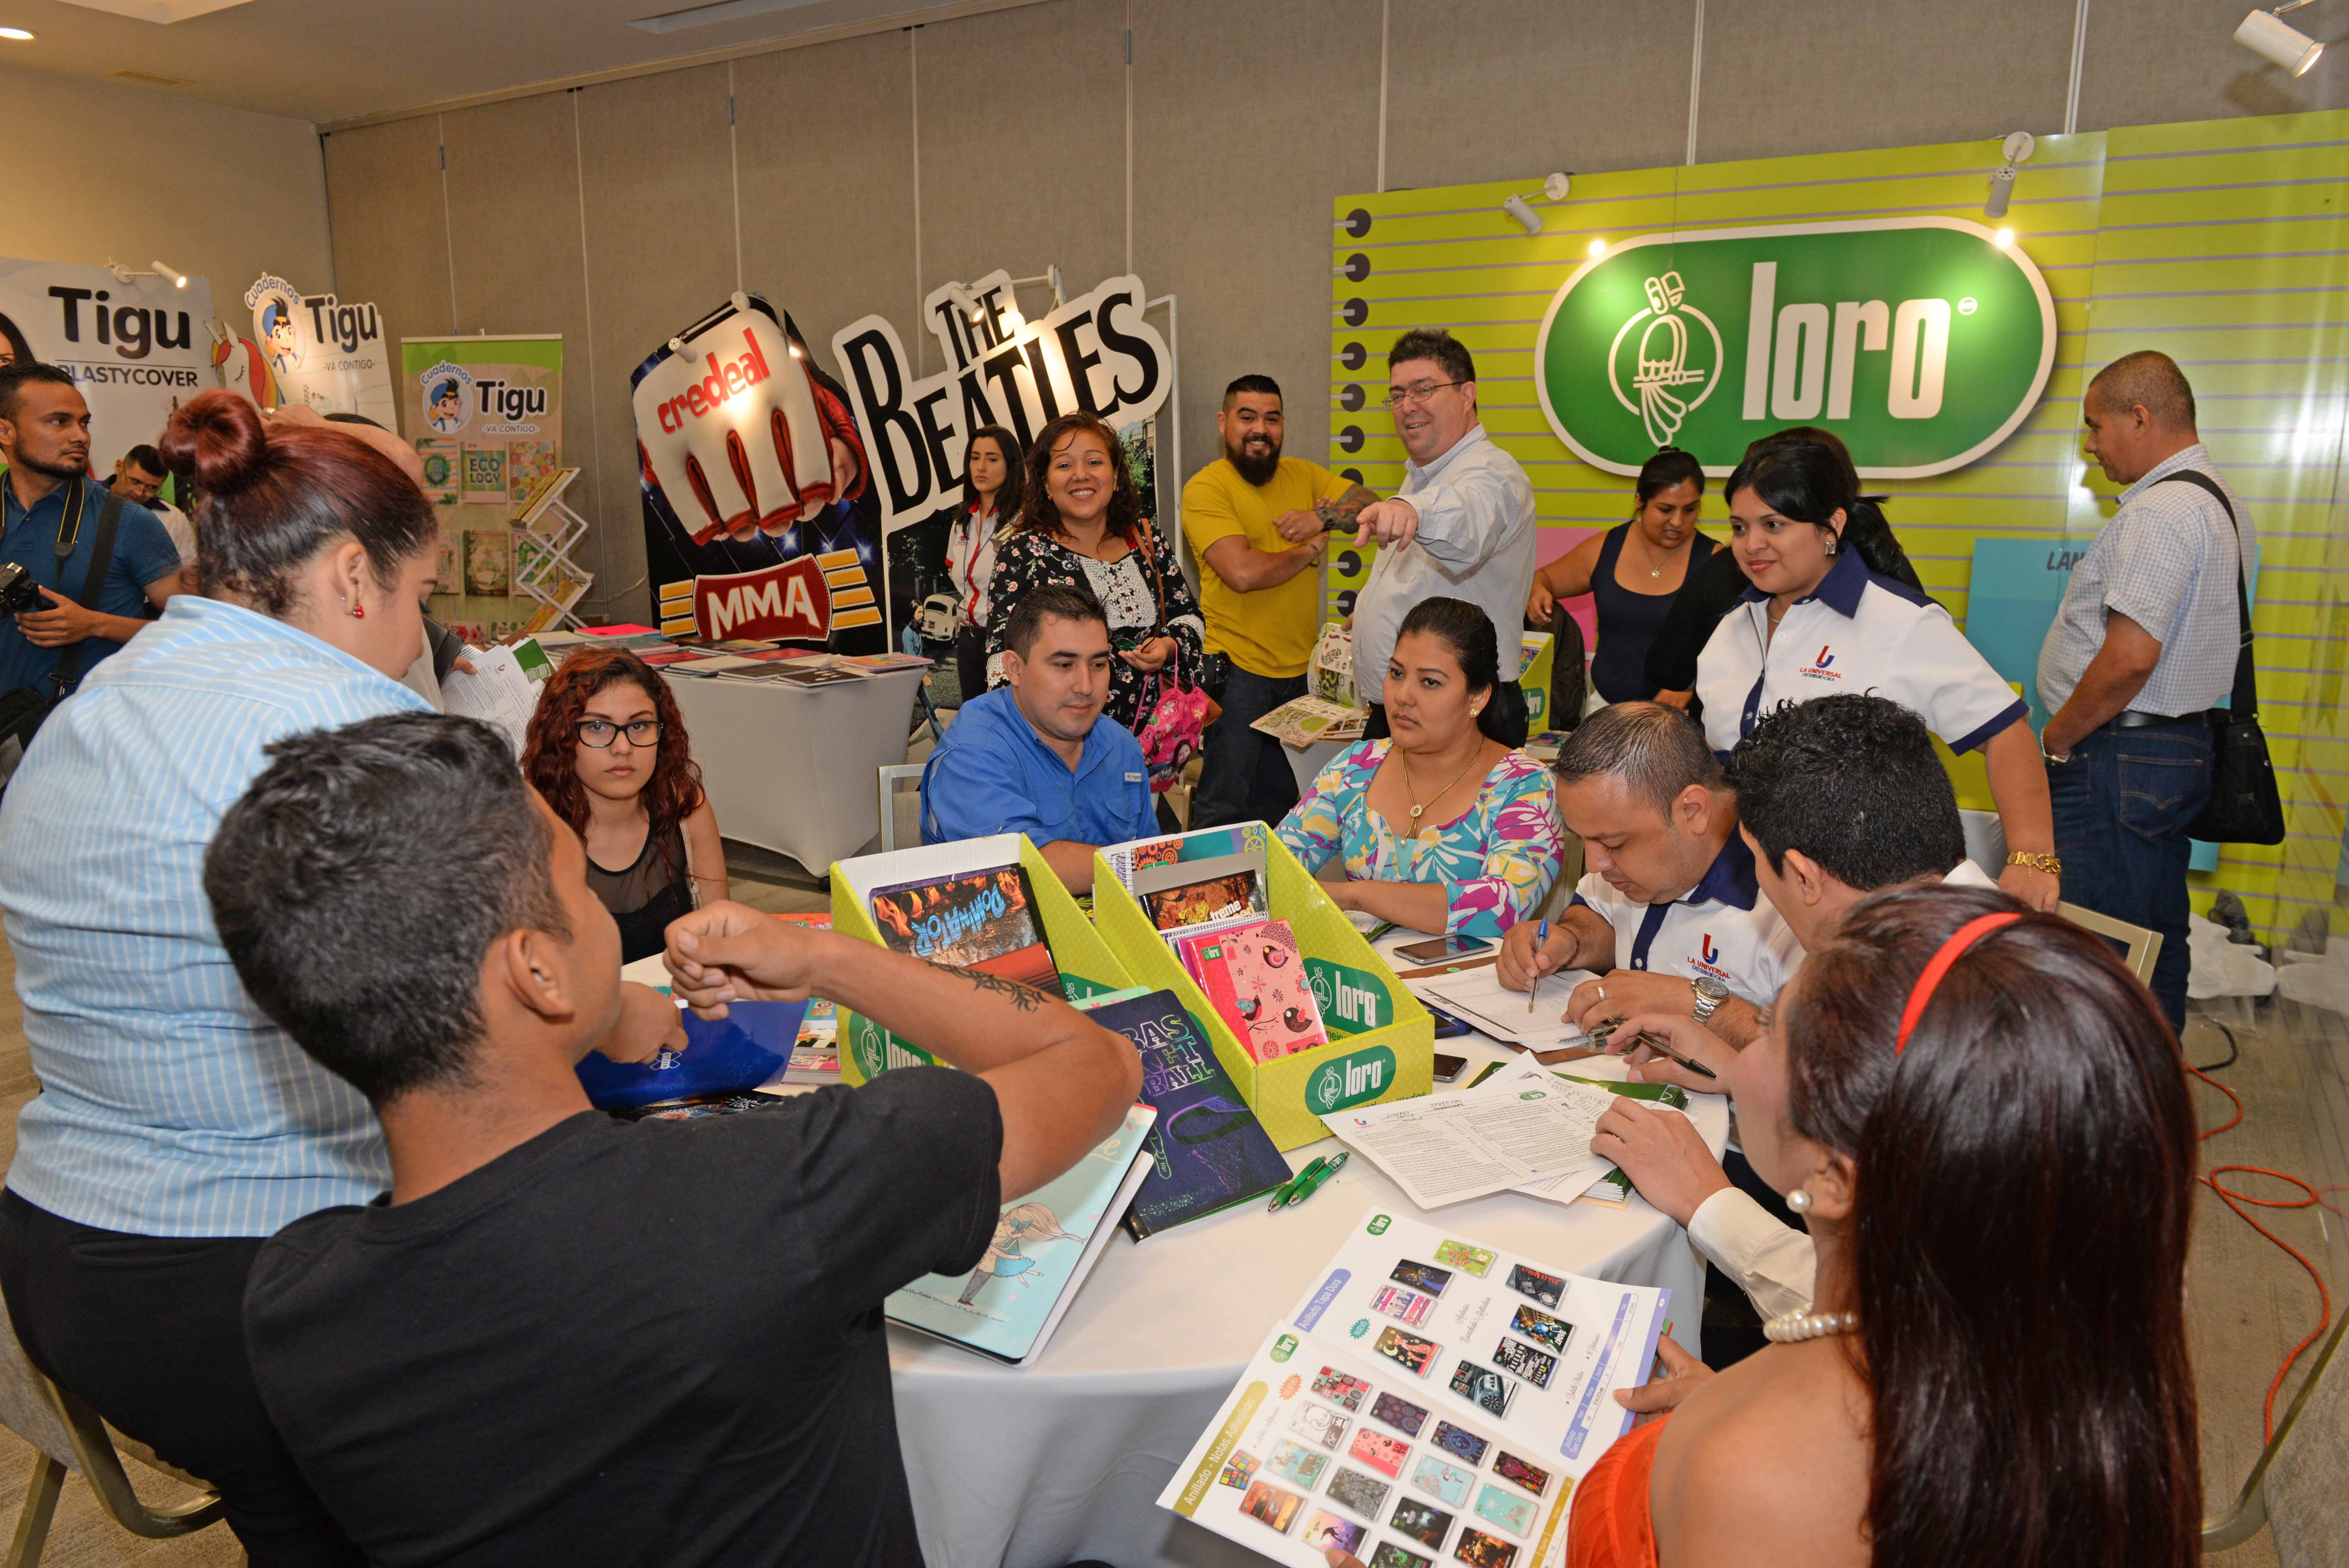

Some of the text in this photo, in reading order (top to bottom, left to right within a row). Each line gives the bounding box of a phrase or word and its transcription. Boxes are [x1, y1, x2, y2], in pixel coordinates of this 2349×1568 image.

[246, 274, 300, 308] Cuadernos
[48, 286, 191, 359] Tigu
[305, 296, 378, 353] Tigu
[935, 286, 1014, 371] THE
[1743, 261, 1951, 421] loro
[421, 362, 473, 385] Cuadernos
[657, 327, 770, 434] credeal
[476, 381, 545, 421] Tigu
[469, 458, 500, 472] ECO
[706, 574, 822, 640] MMA
[1808, 668, 1842, 679] UNIVERSAL
[911, 883, 1006, 956] DOMINATOR
[1687, 956, 1731, 979] LA UNIVERSAL
[1692, 964, 1725, 983] DISTRIBUIDORA
[1335, 970, 1376, 1027] loro
[1345, 1059, 1383, 1098] loro
[1299, 1278, 1342, 1329] Anillado Tapa Dura
[1184, 1469, 1212, 1506] Anillado
[1209, 1438, 1231, 1463] Notas
[1225, 1399, 1256, 1438] Adhesivas
